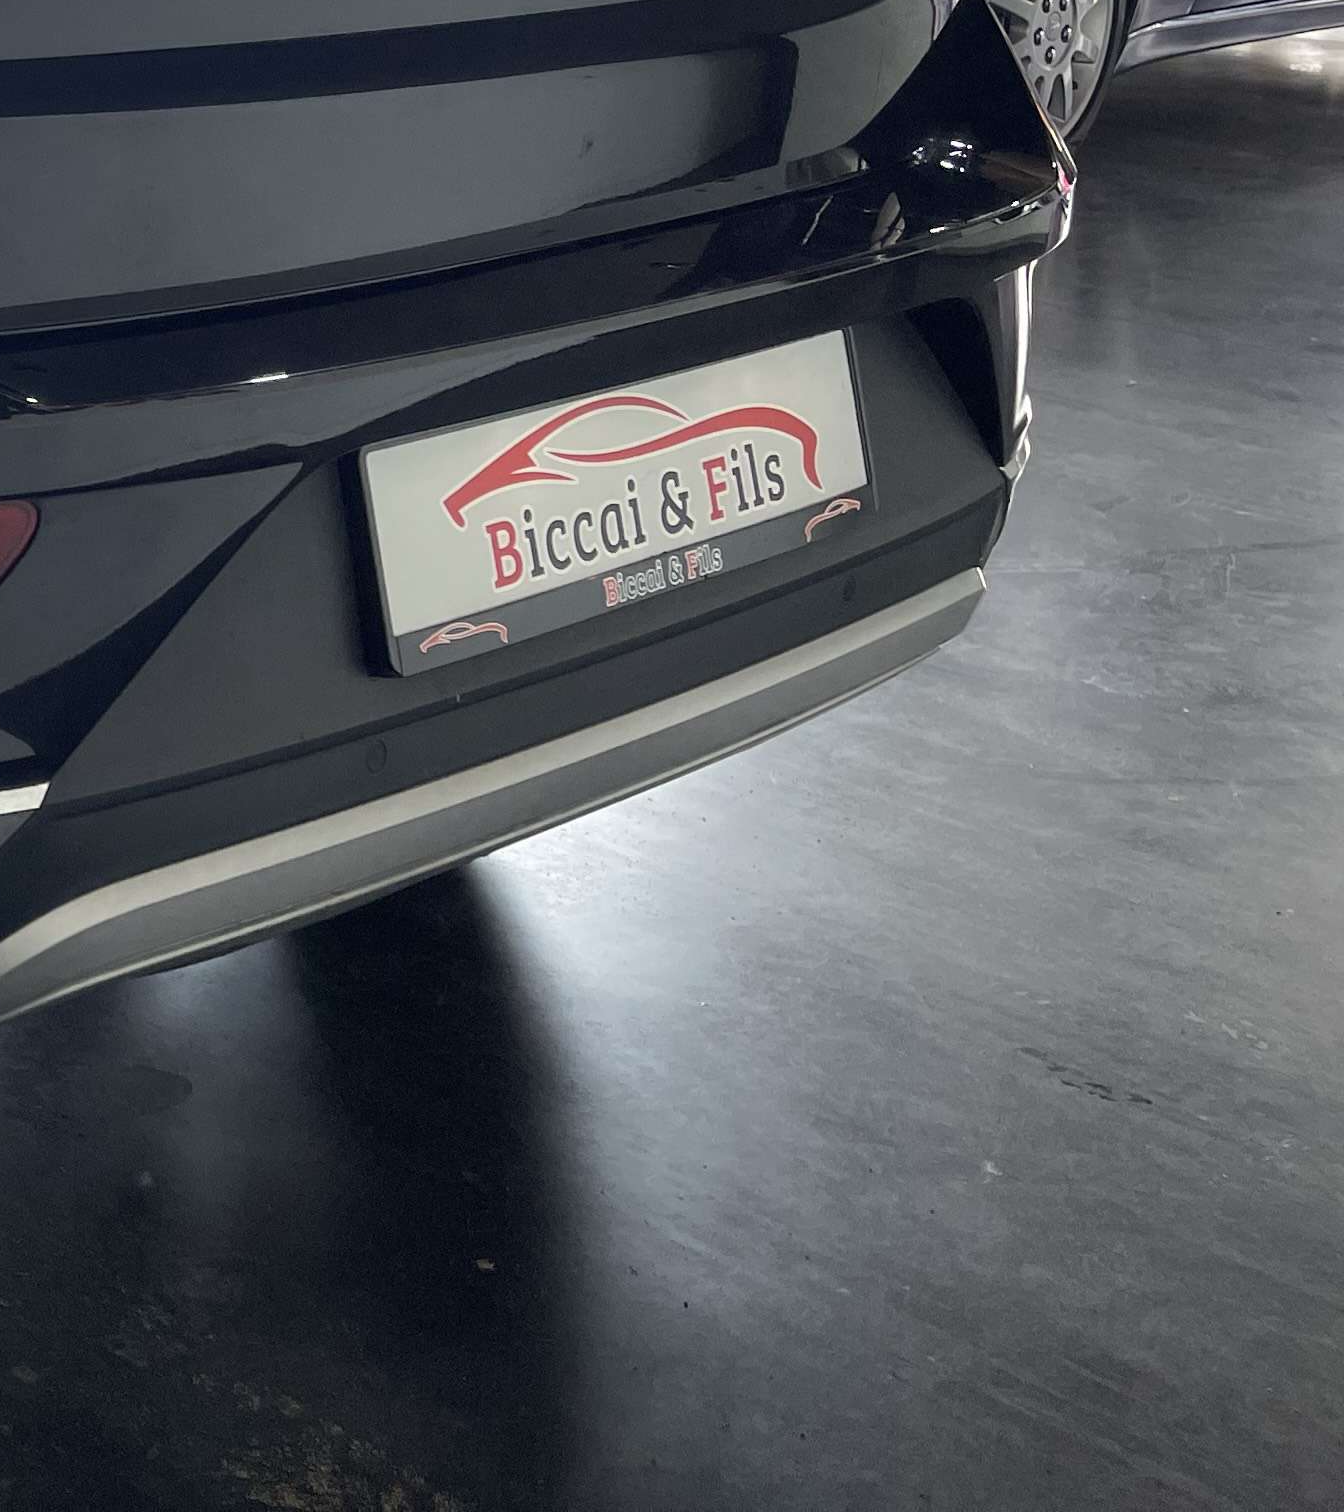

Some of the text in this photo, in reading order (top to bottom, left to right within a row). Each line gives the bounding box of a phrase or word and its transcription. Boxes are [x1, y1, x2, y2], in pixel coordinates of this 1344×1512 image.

[484, 442, 786, 590] Biccai & Fils
[602, 545, 724, 607] Biccai & Fils
